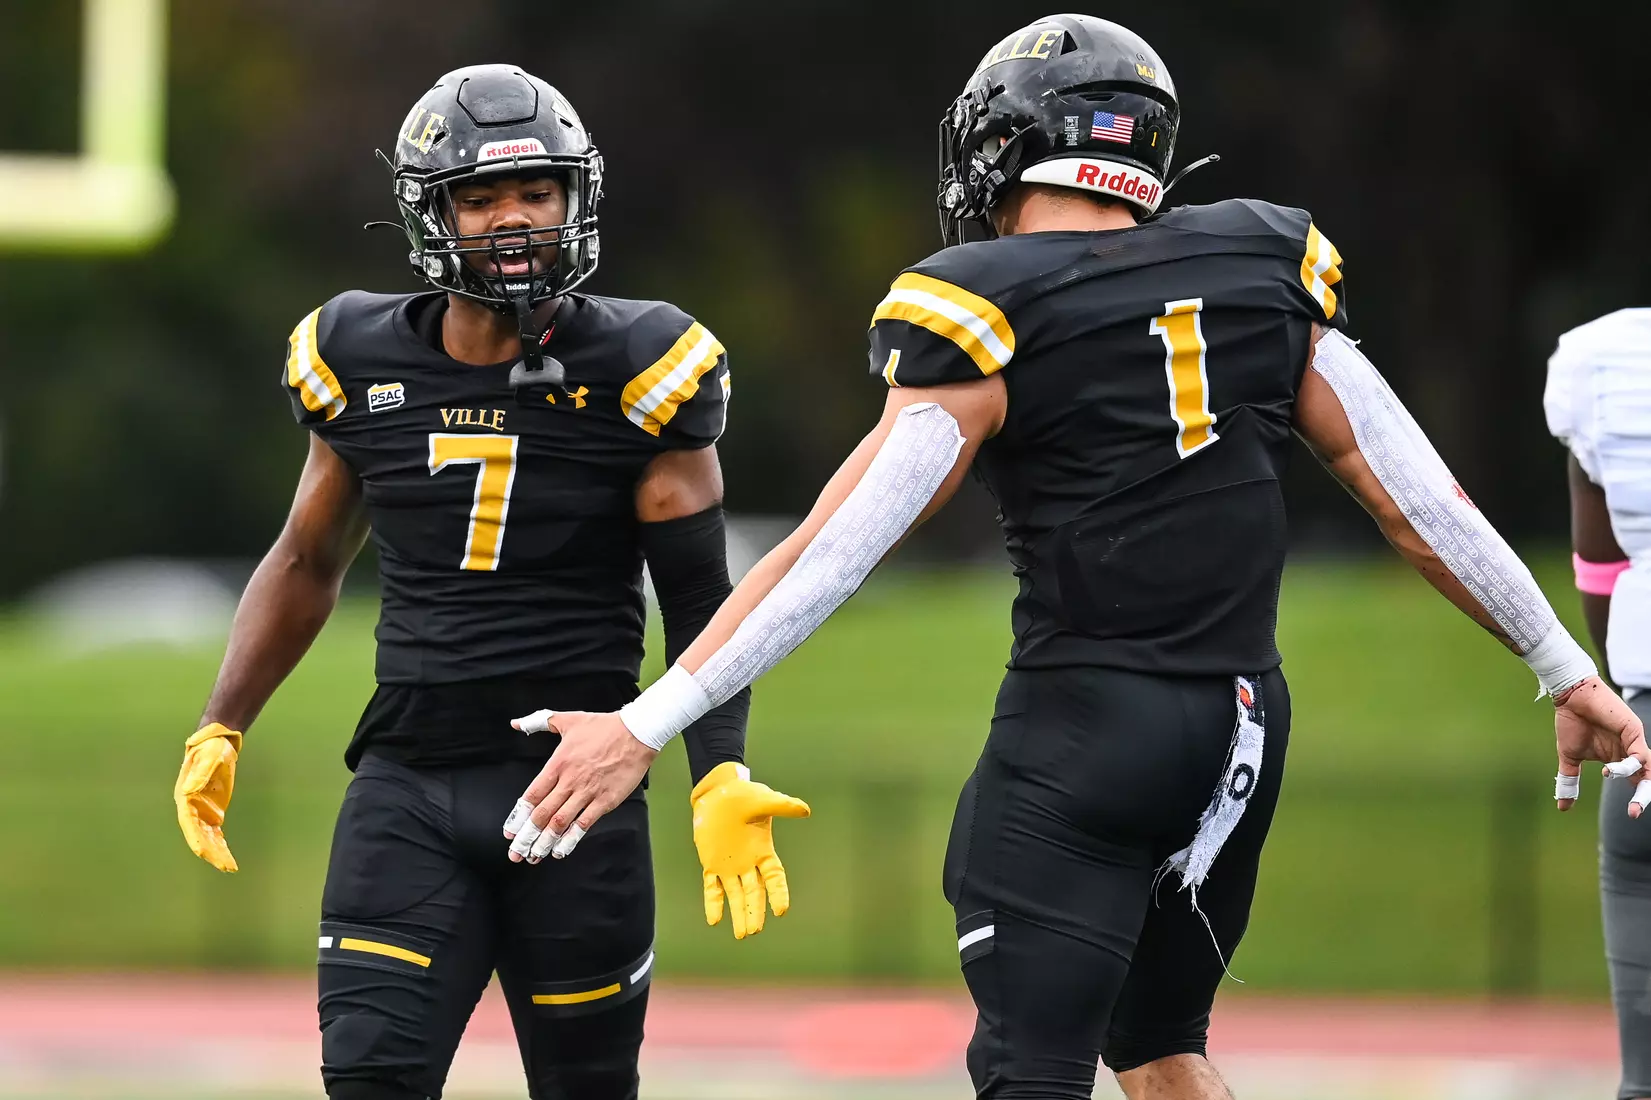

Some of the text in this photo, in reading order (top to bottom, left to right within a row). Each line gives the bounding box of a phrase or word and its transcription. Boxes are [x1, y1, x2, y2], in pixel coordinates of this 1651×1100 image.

[1136, 63, 1155, 79] MJ
[486, 143, 539, 157] Riddell
[1075, 162, 1159, 205] Riddell
[1149, 297, 1221, 460] 1
[370, 388, 402, 404] PSAC
[439, 408, 507, 432] VILLE
[427, 433, 520, 572] 7
[1461, 555, 1483, 582] BATTLE
[1482, 563, 1507, 591] BATTLE
[1468, 582, 1493, 608] BATTLE
[1490, 589, 1514, 616] BATTLE
[1511, 595, 1533, 621] BATTLE
